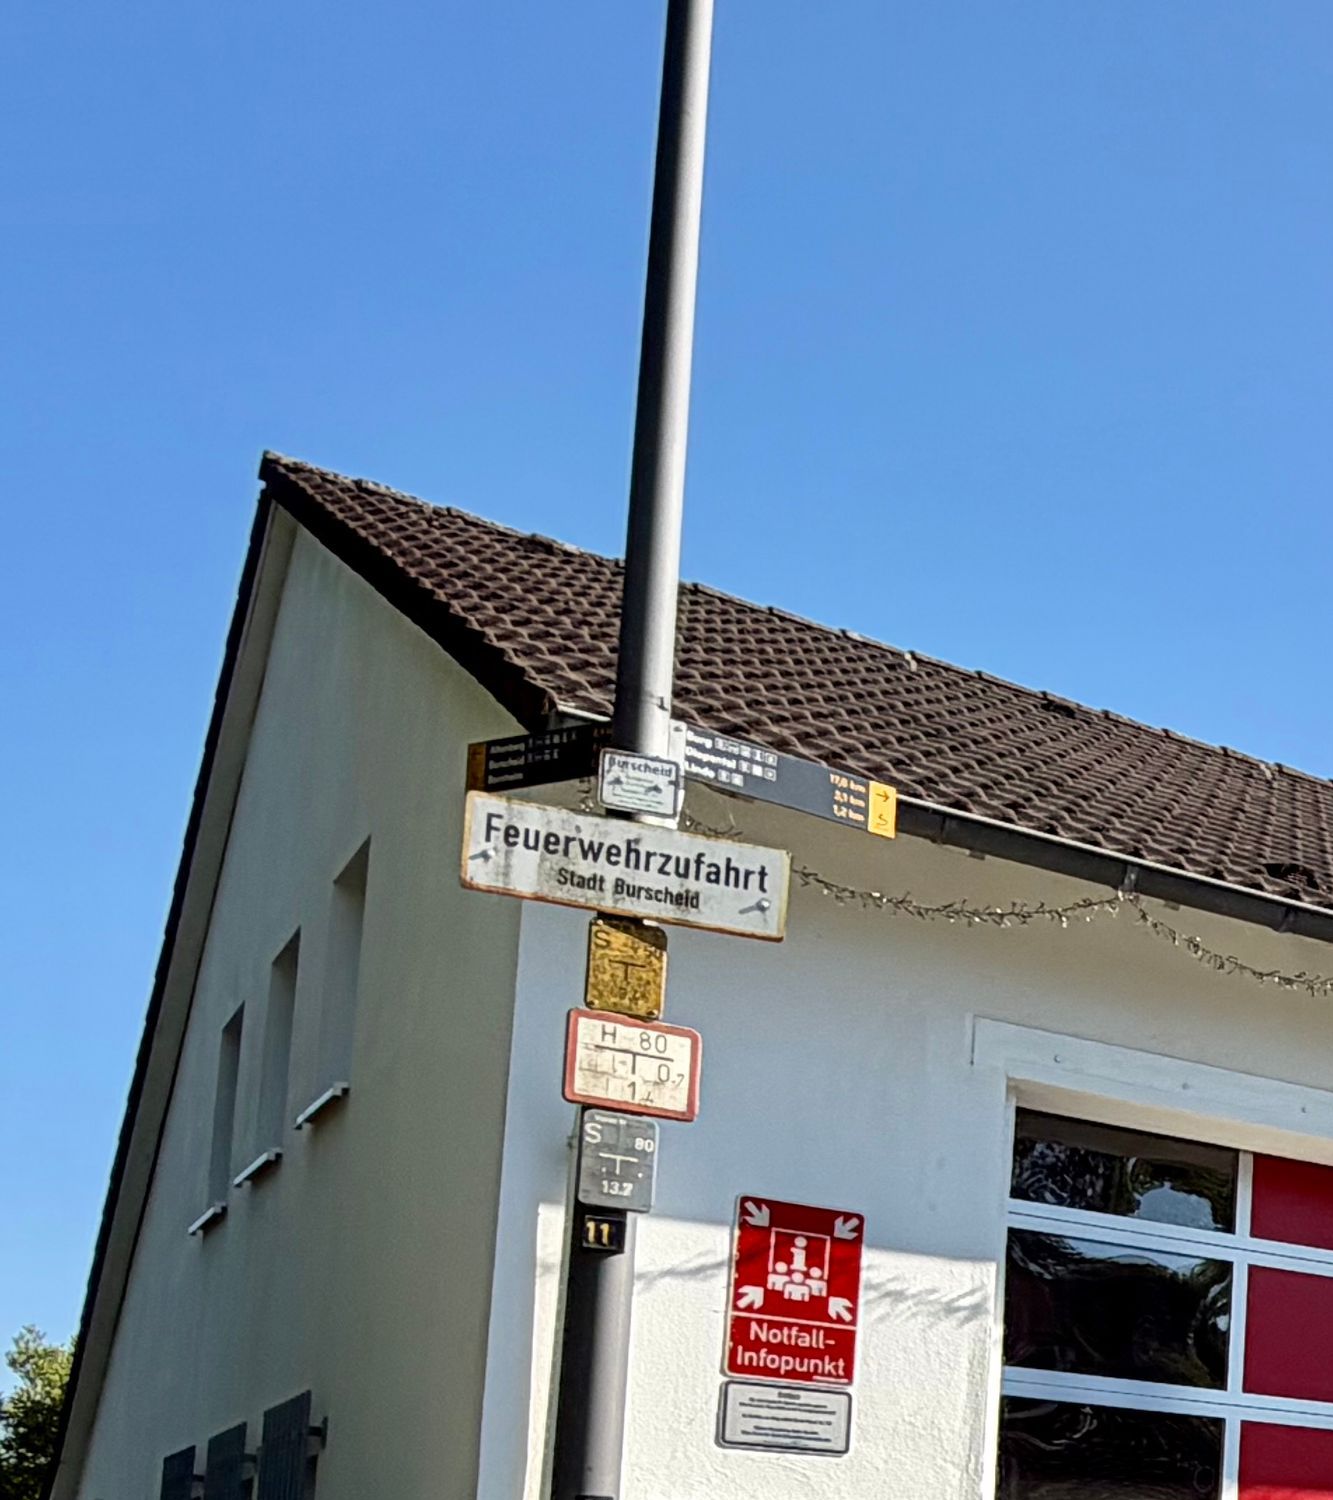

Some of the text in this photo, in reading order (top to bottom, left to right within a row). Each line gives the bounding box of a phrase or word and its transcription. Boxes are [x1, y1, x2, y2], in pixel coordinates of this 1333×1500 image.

[484, 812, 769, 893] Feuerwehrzufahrt
[556, 867, 700, 909] Stadt Burscheid
[601, 1024, 667, 1054] H 80
[584, 1122, 655, 1153] S 80
[586, 1221, 610, 1246] 11
[749, 1321, 836, 1349] Notfall-
[736, 1346, 846, 1376] Infopunkt
